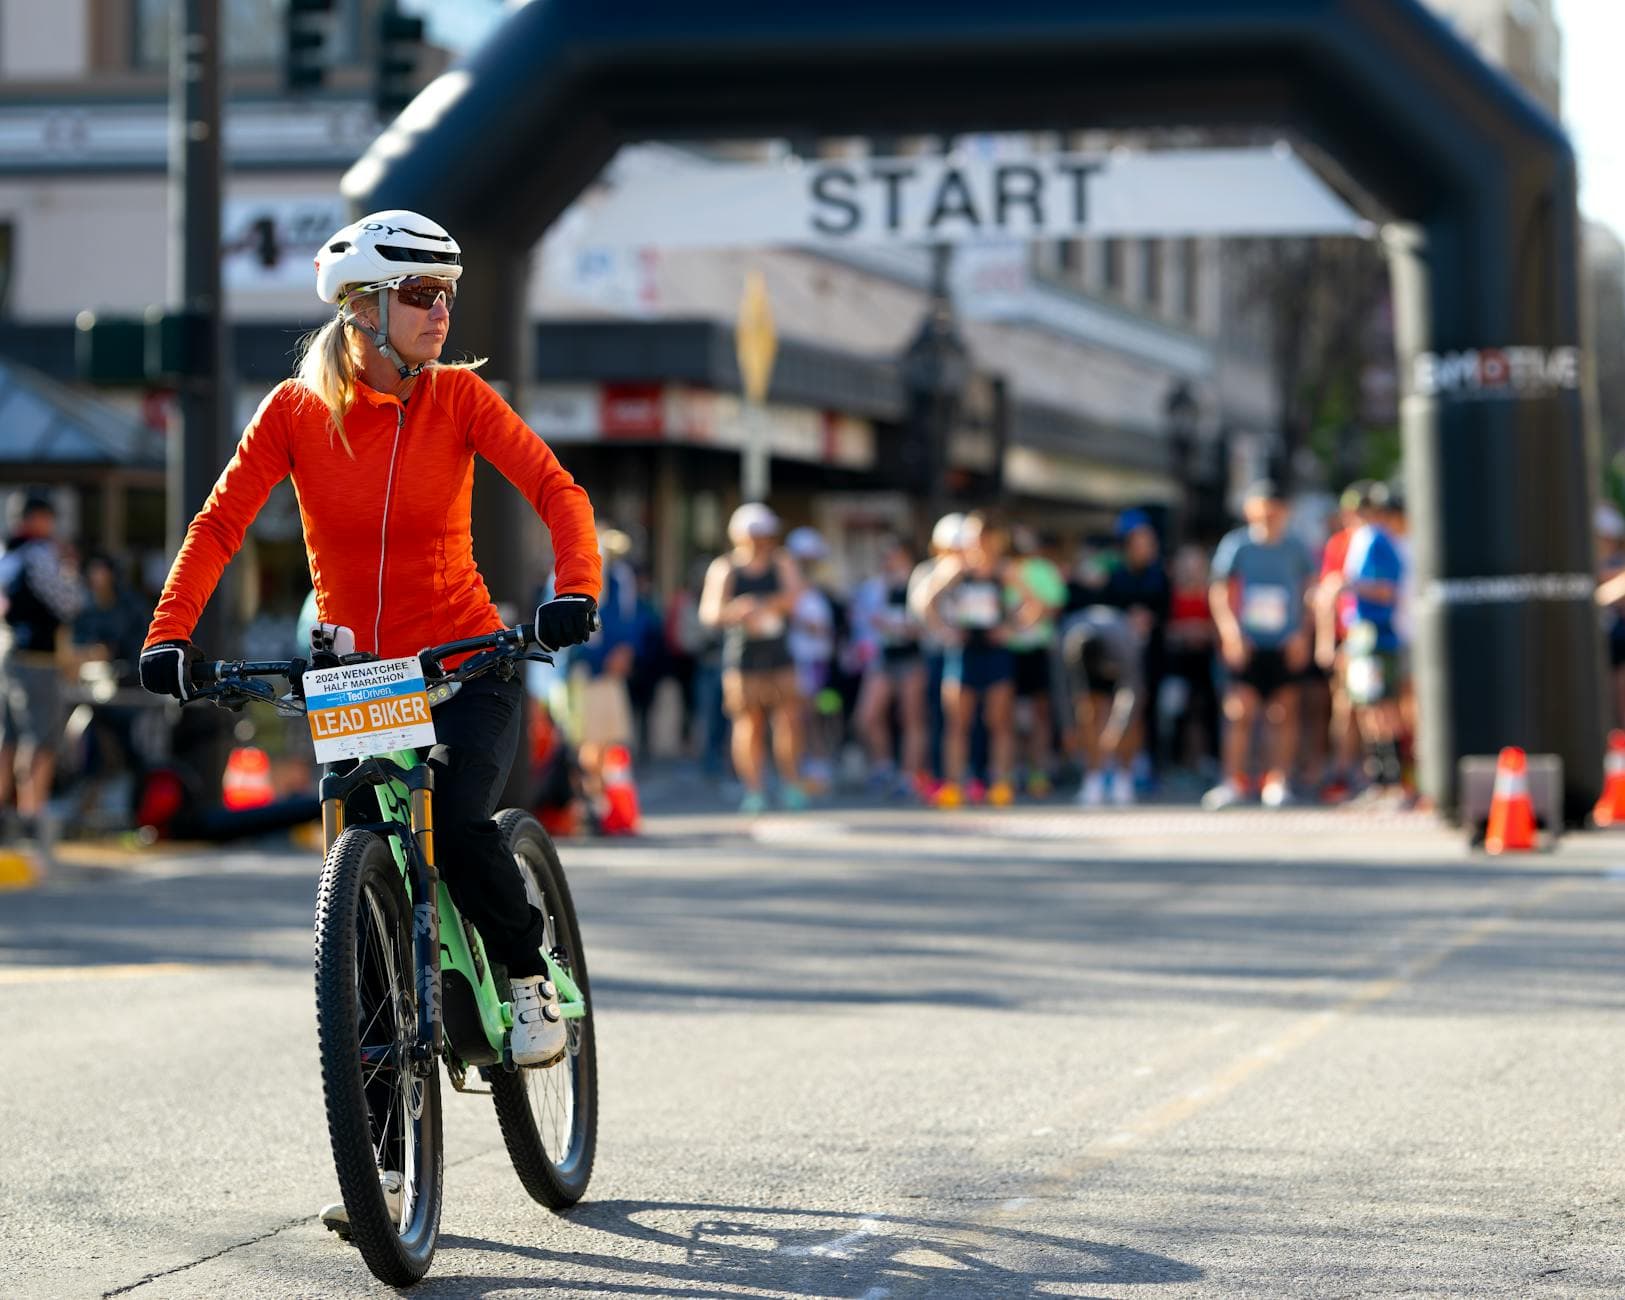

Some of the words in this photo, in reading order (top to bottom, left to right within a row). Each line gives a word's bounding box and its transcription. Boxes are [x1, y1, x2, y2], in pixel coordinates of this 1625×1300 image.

[811, 159, 1106, 237] START
[360, 223, 400, 235] DY
[315, 672, 339, 684] 2024
[342, 662, 409, 680] WENATCHEE
[324, 681, 349, 692] HALF
[351, 672, 404, 689] MARATHON
[313, 708, 365, 737] LEAD
[368, 696, 428, 728] BIKER
[424, 964, 442, 1023] FOX
